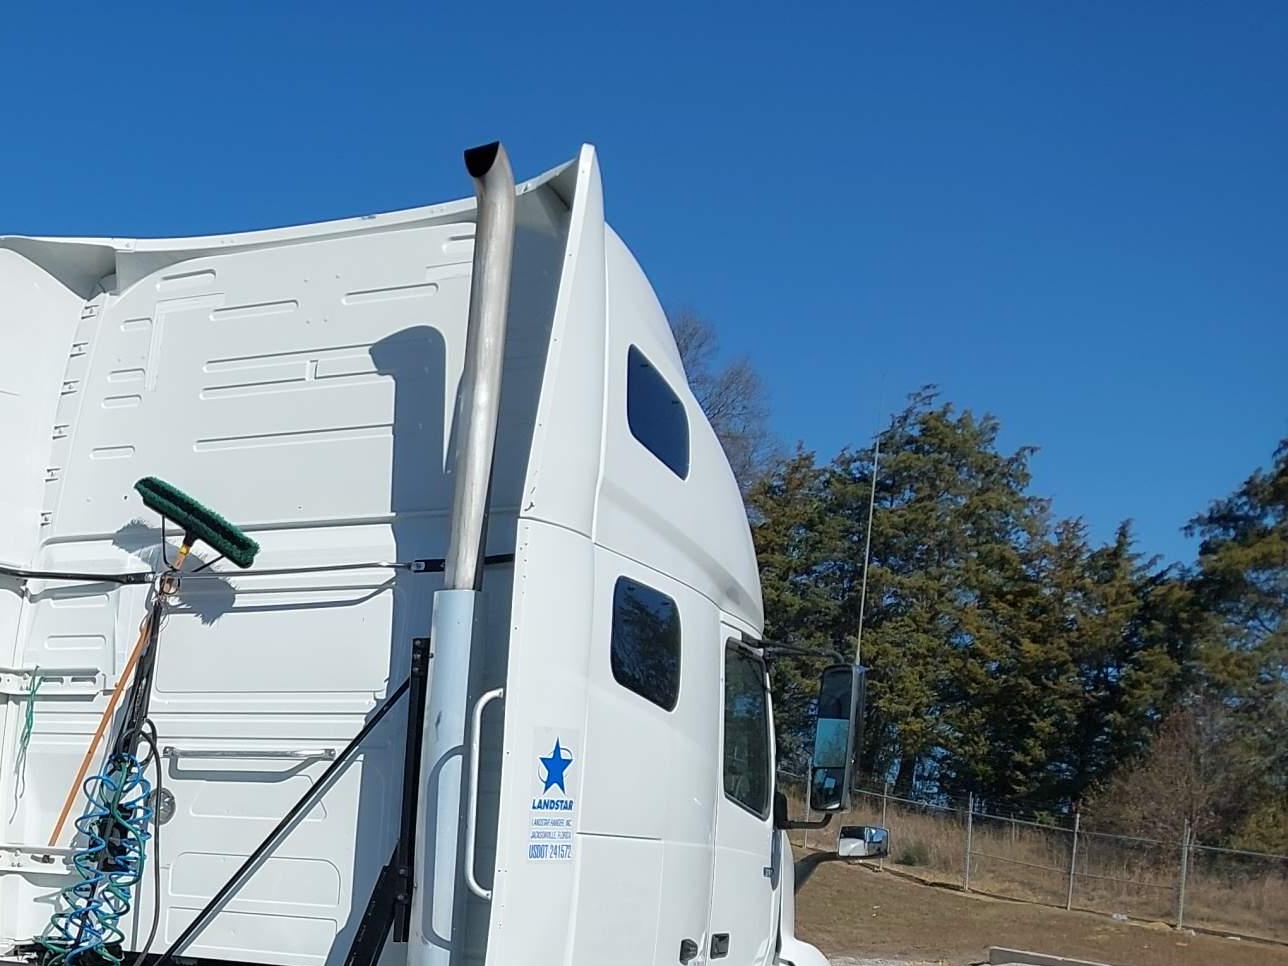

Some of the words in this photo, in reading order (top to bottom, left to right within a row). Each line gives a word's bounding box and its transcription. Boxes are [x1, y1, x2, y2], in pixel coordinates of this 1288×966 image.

[531, 799, 574, 810] LANDSTAR
[528, 844, 549, 859] USDOT
[549, 844, 572, 859] 241572
